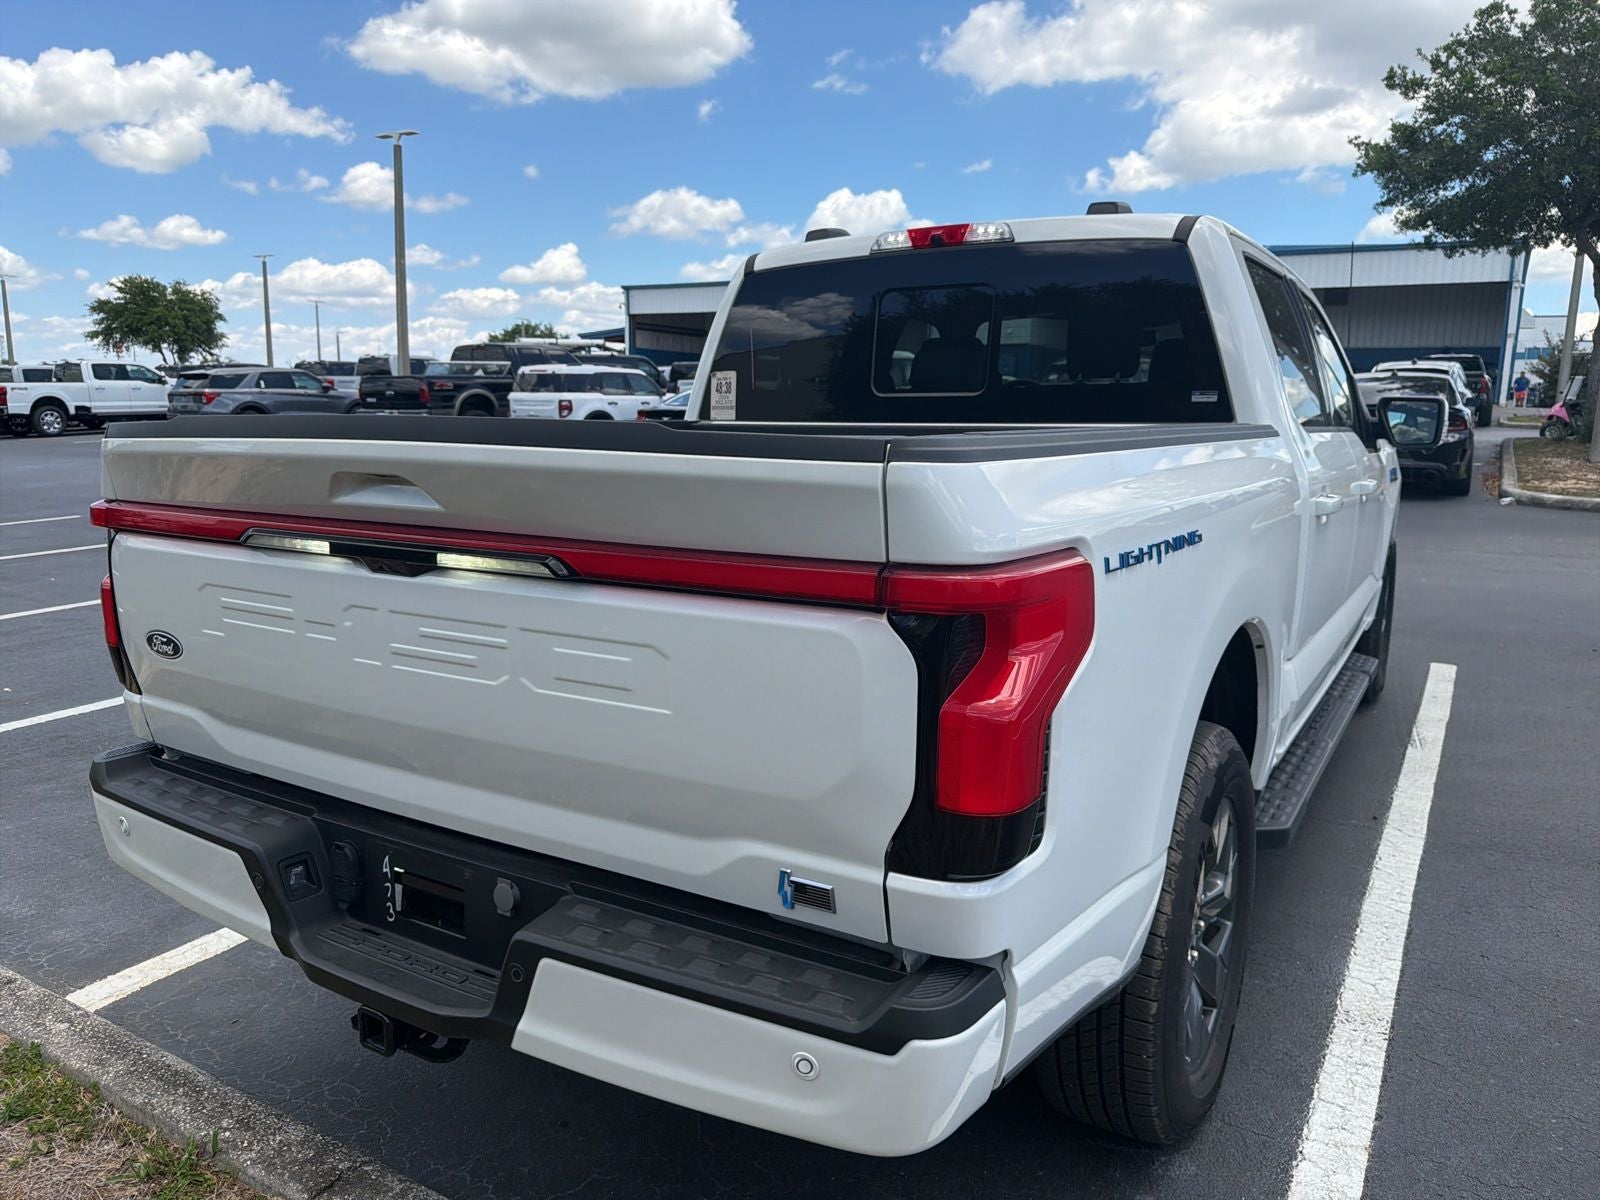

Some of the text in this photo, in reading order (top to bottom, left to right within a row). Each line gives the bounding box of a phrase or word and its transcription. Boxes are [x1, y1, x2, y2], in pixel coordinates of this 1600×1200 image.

[1104, 529, 1203, 575] LIGHTNING
[152, 634, 175, 655] Ford
[352, 939, 470, 985] FORD
